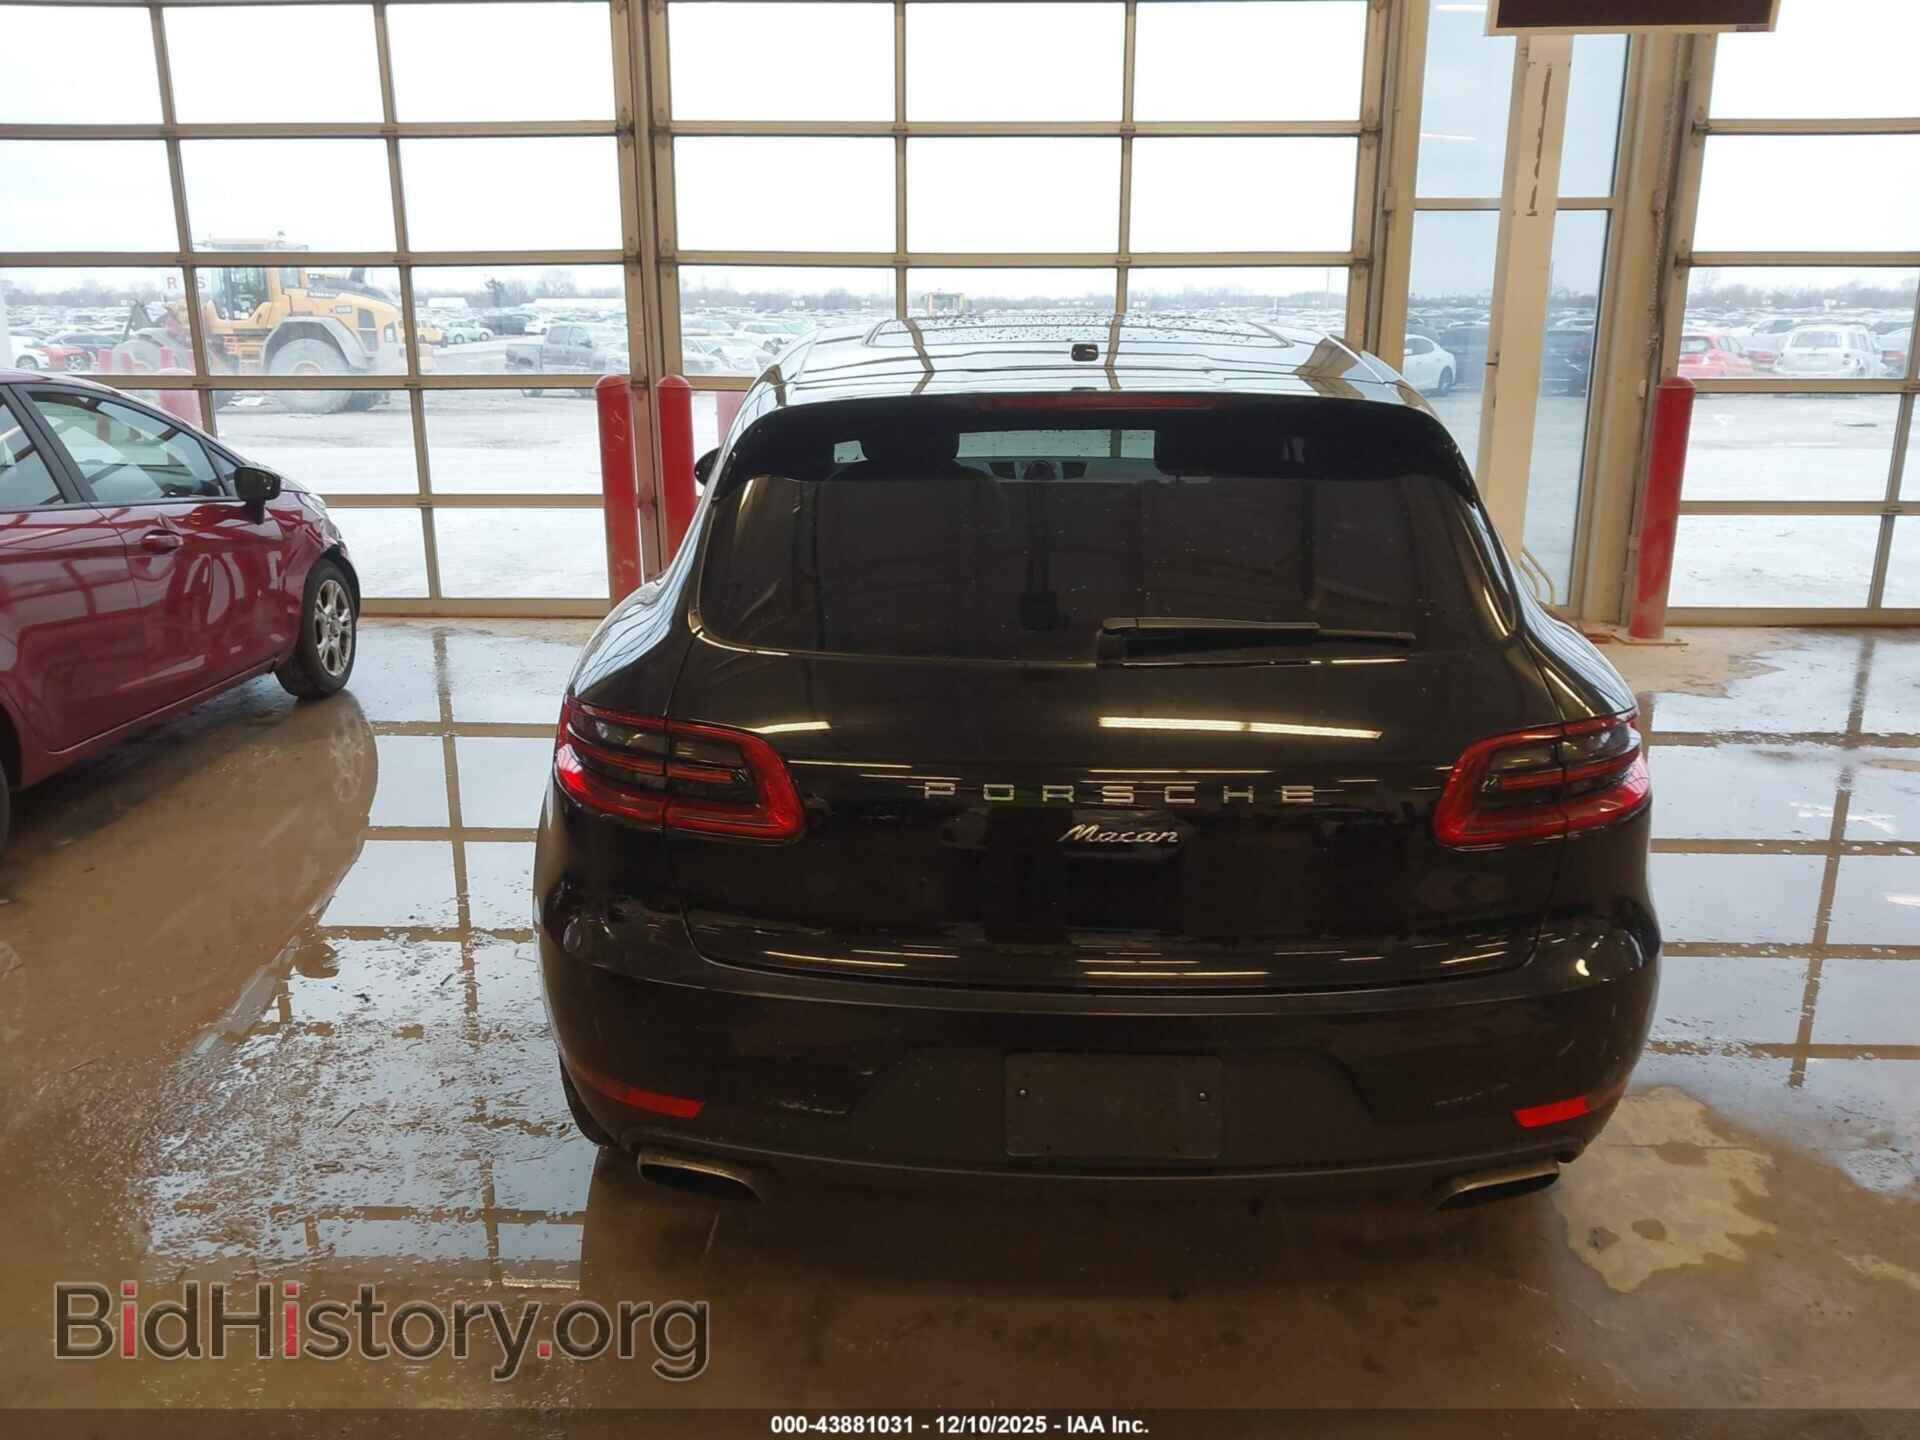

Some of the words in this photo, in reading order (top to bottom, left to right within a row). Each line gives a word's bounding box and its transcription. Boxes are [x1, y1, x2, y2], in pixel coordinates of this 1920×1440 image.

[167, 276, 177, 289] R
[924, 781, 1315, 804] PORSCHE
[1057, 823, 1180, 844] Macan
